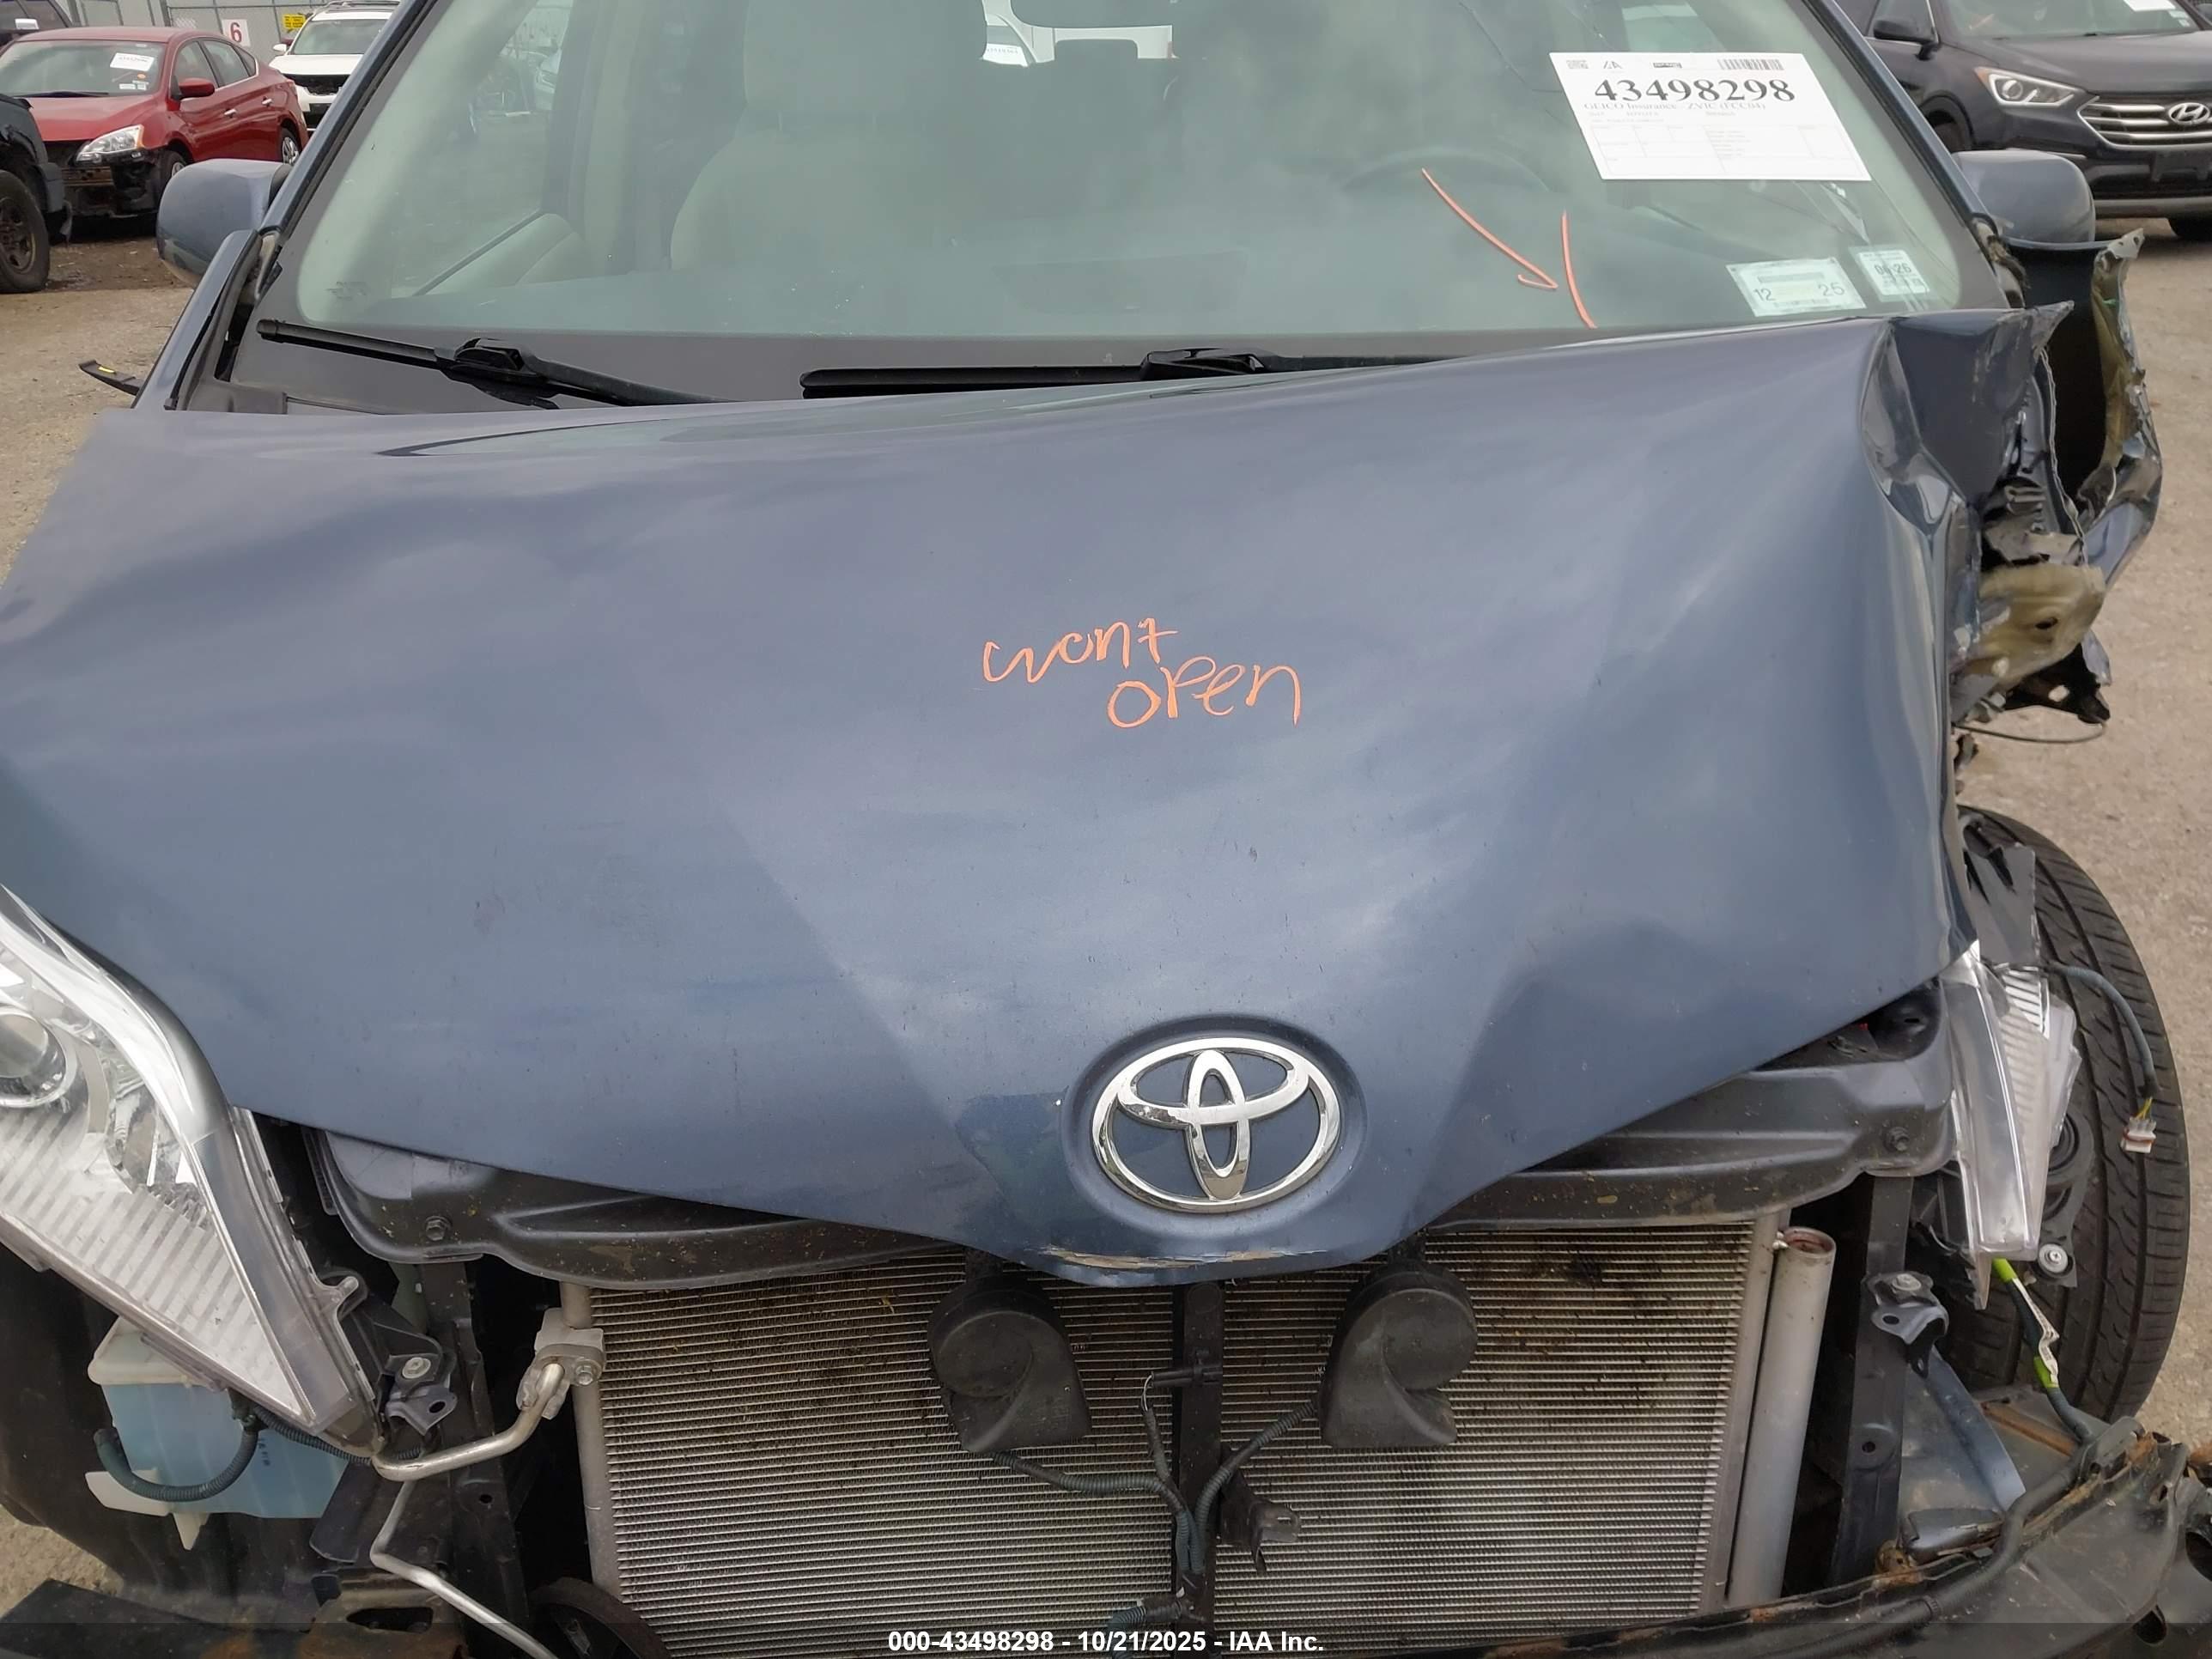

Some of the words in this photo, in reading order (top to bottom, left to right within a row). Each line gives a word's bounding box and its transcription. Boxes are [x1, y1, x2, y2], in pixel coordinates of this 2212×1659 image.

[230, 21, 242, 43] 6
[1595, 78, 1796, 102] 43498298
[1753, 288, 1775, 301] 12
[1818, 281, 1845, 297] 25
